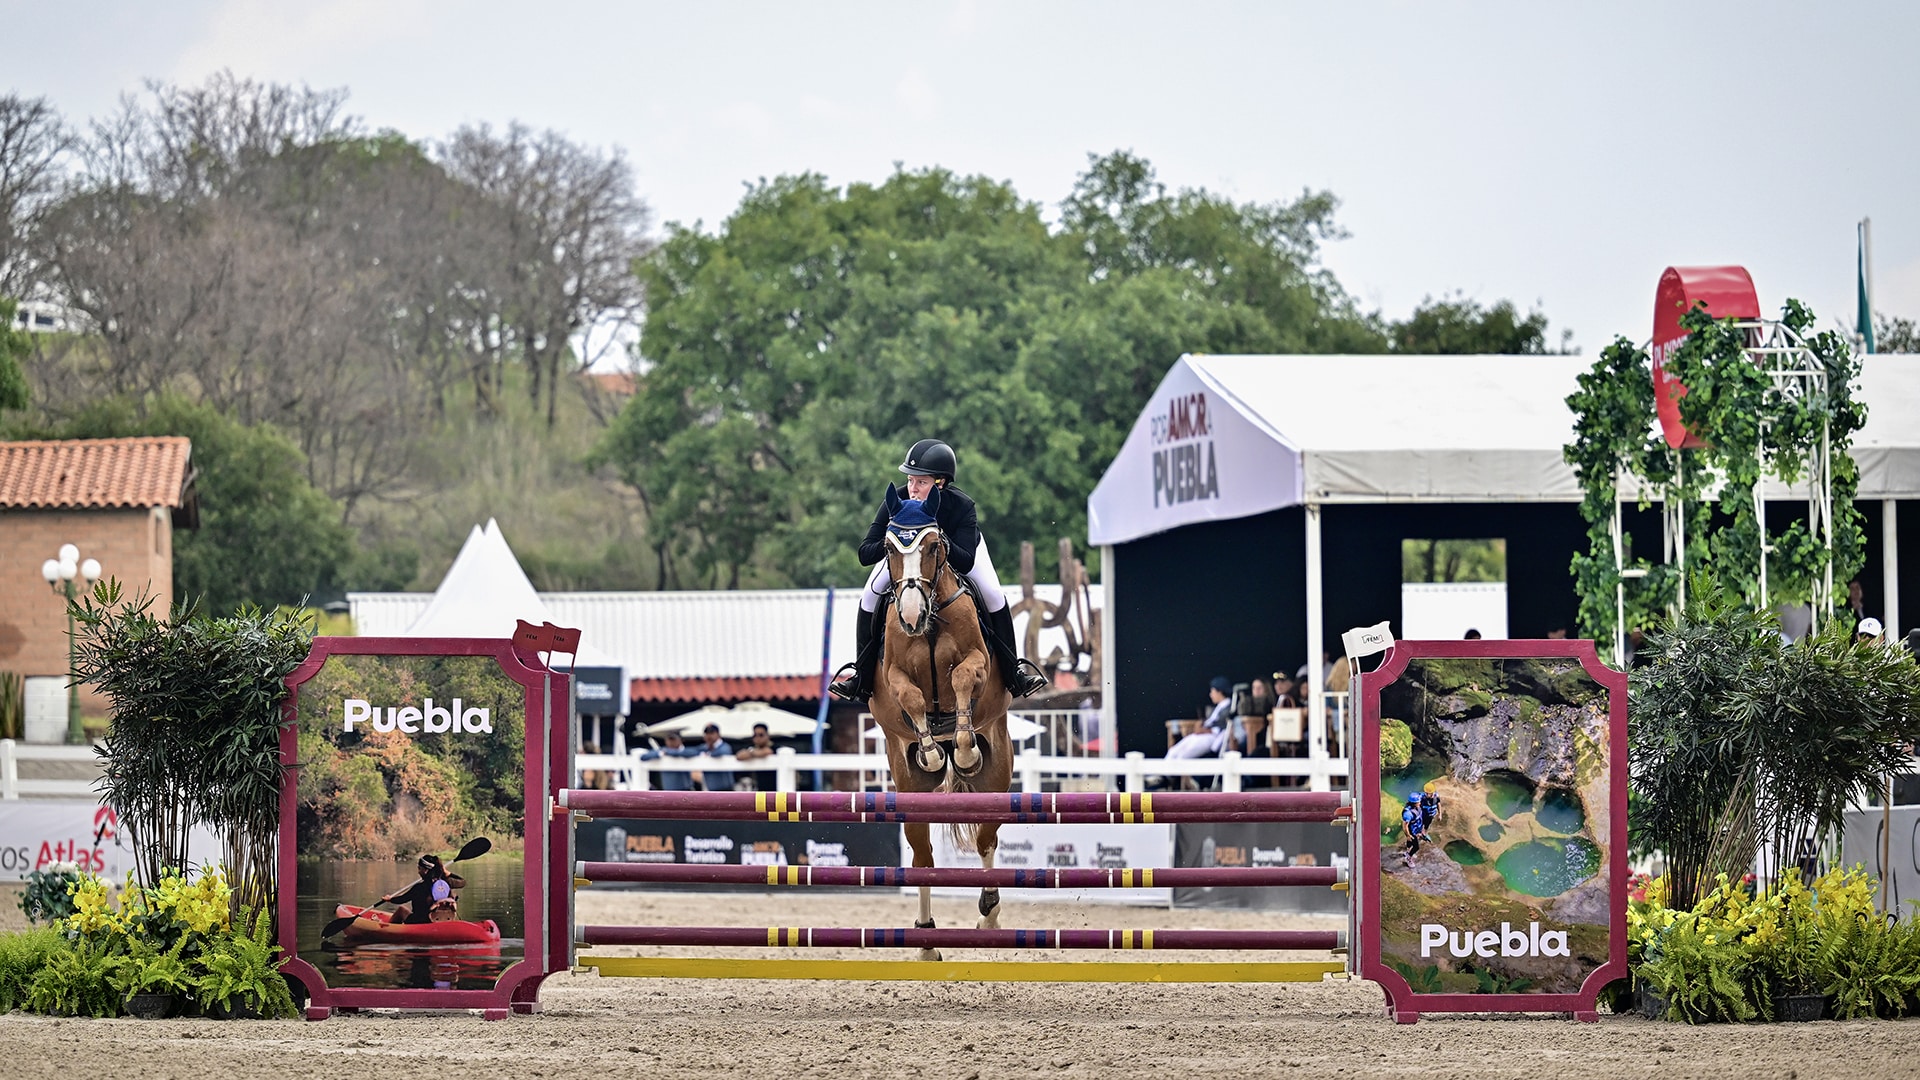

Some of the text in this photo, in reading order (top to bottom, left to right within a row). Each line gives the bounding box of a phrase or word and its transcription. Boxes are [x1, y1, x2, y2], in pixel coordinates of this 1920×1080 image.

[1168, 391, 1208, 442] AMOR
[1153, 440, 1219, 509] PUEBLA
[344, 698, 493, 734] Puebla
[0, 838, 105, 873] os Atlas
[1421, 921, 1570, 958] Puebla
